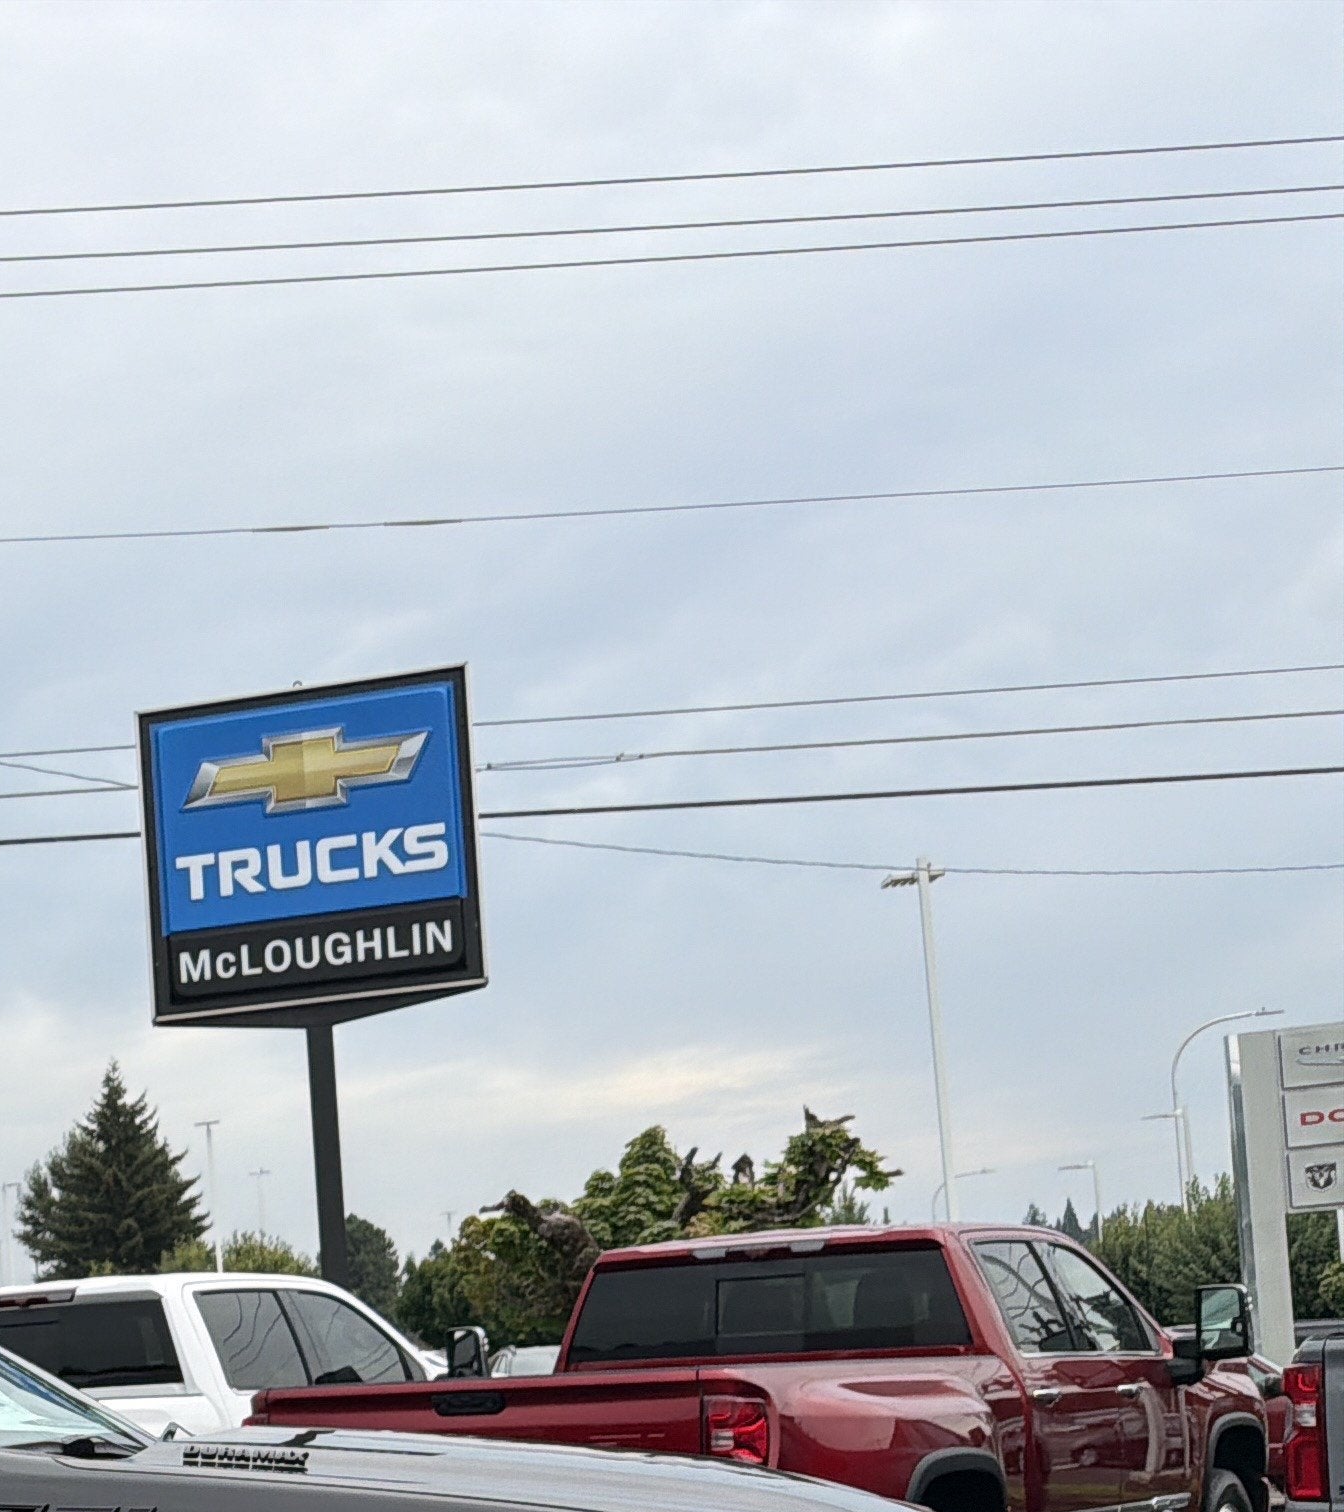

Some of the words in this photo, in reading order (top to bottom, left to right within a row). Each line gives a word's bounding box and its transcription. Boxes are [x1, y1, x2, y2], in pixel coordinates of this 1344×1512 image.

[175, 822, 449, 901] TRUCKS
[178, 919, 454, 984] McLOUGHLIN
[182, 1445, 309, 1467] DURAMAX
